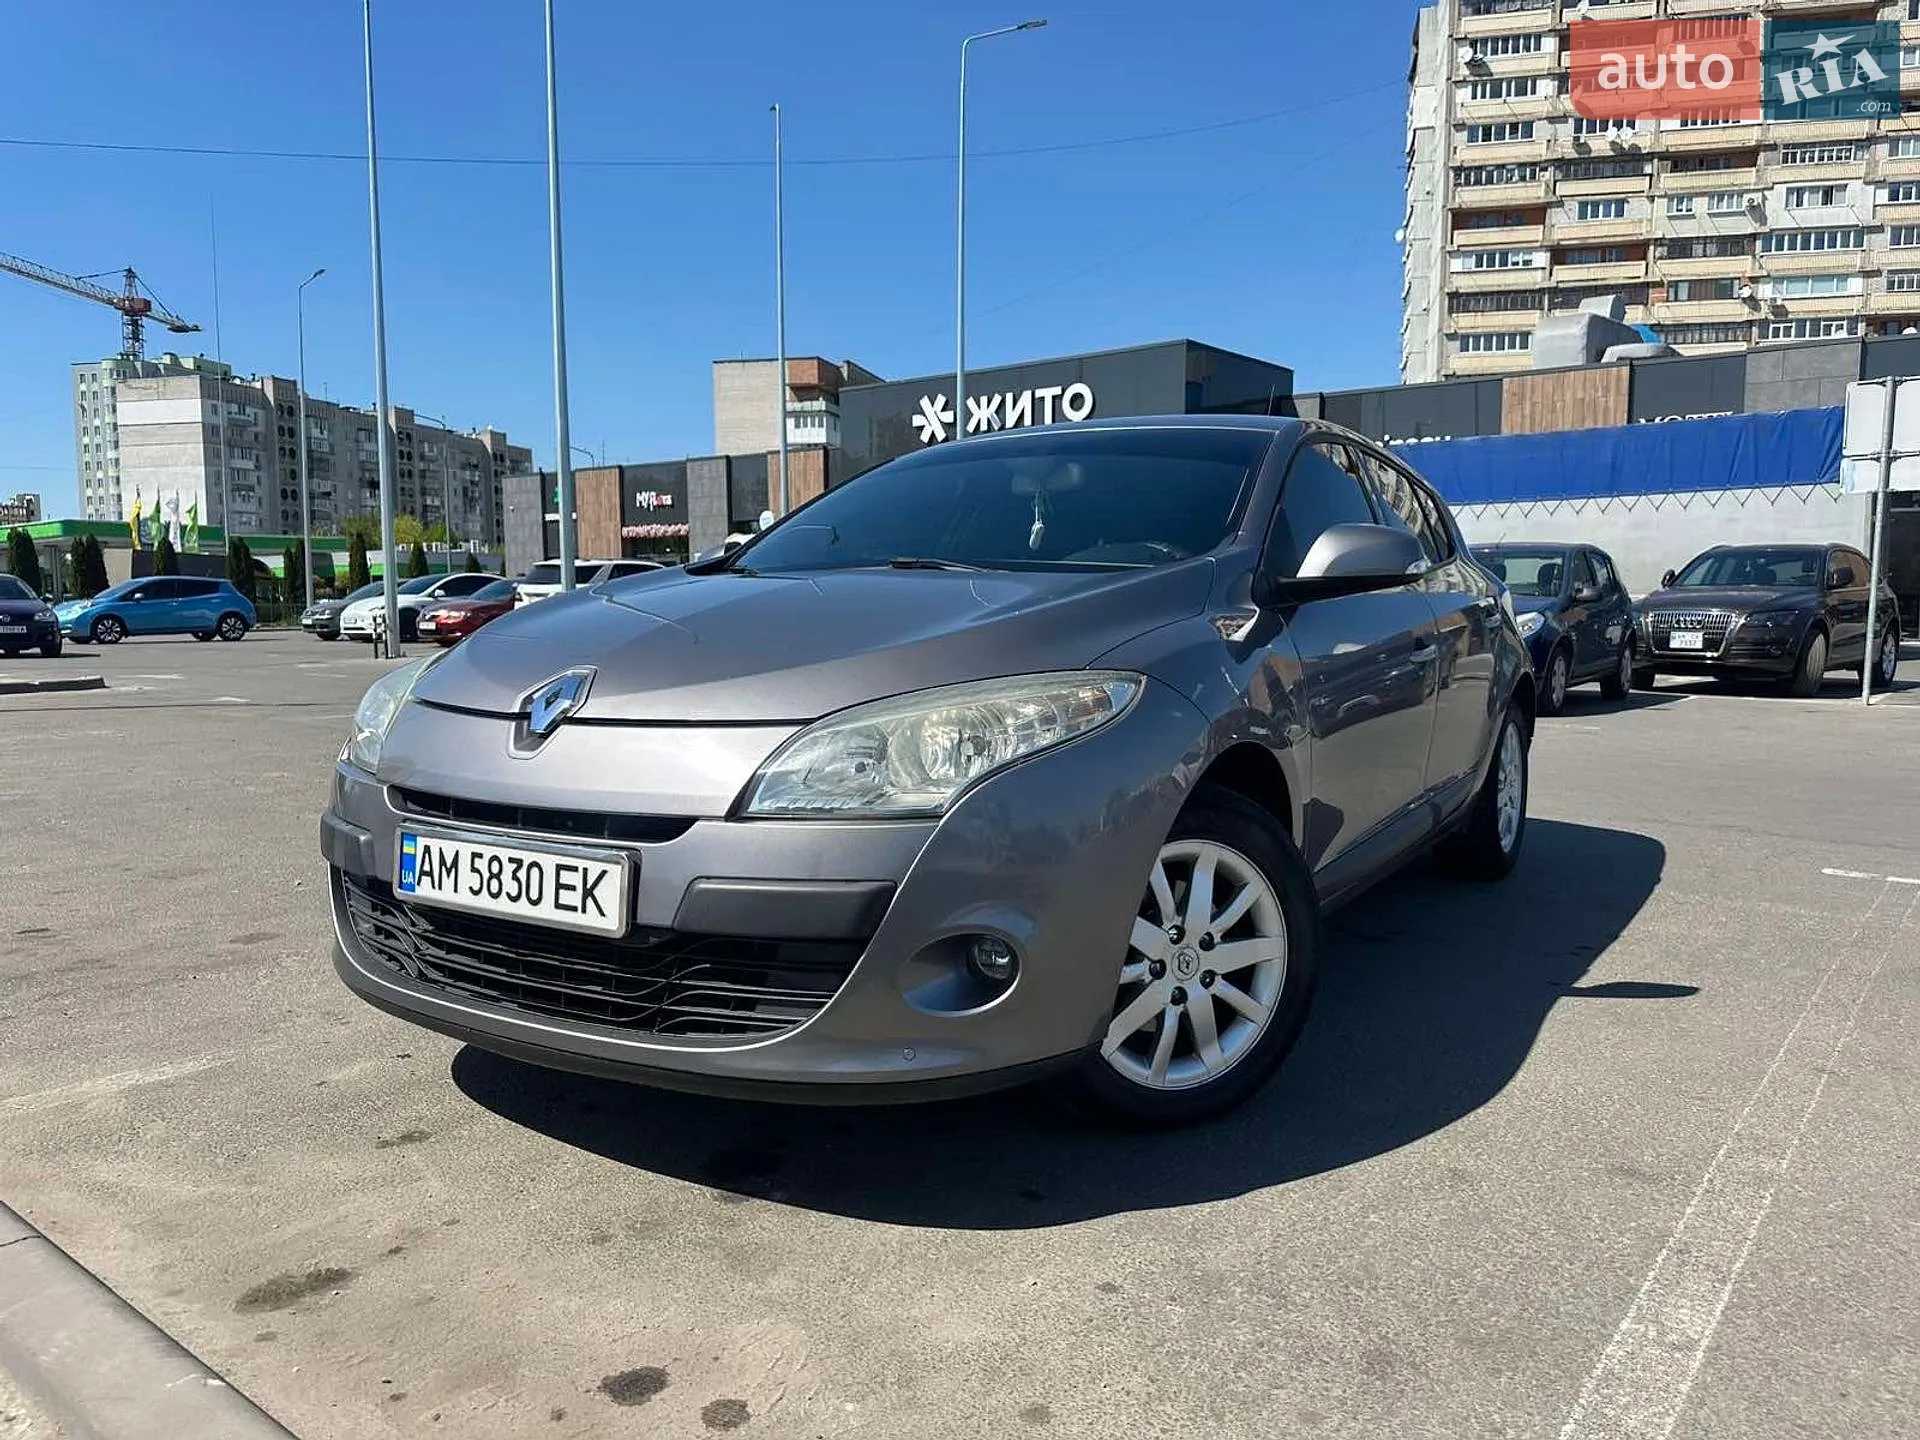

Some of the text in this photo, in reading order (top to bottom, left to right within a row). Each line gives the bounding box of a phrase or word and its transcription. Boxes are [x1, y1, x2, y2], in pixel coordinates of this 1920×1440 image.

[966, 382, 1093, 433] ЖИТО
[401, 870, 415, 885] UA
[416, 844, 609, 918] AM 5830 EK
